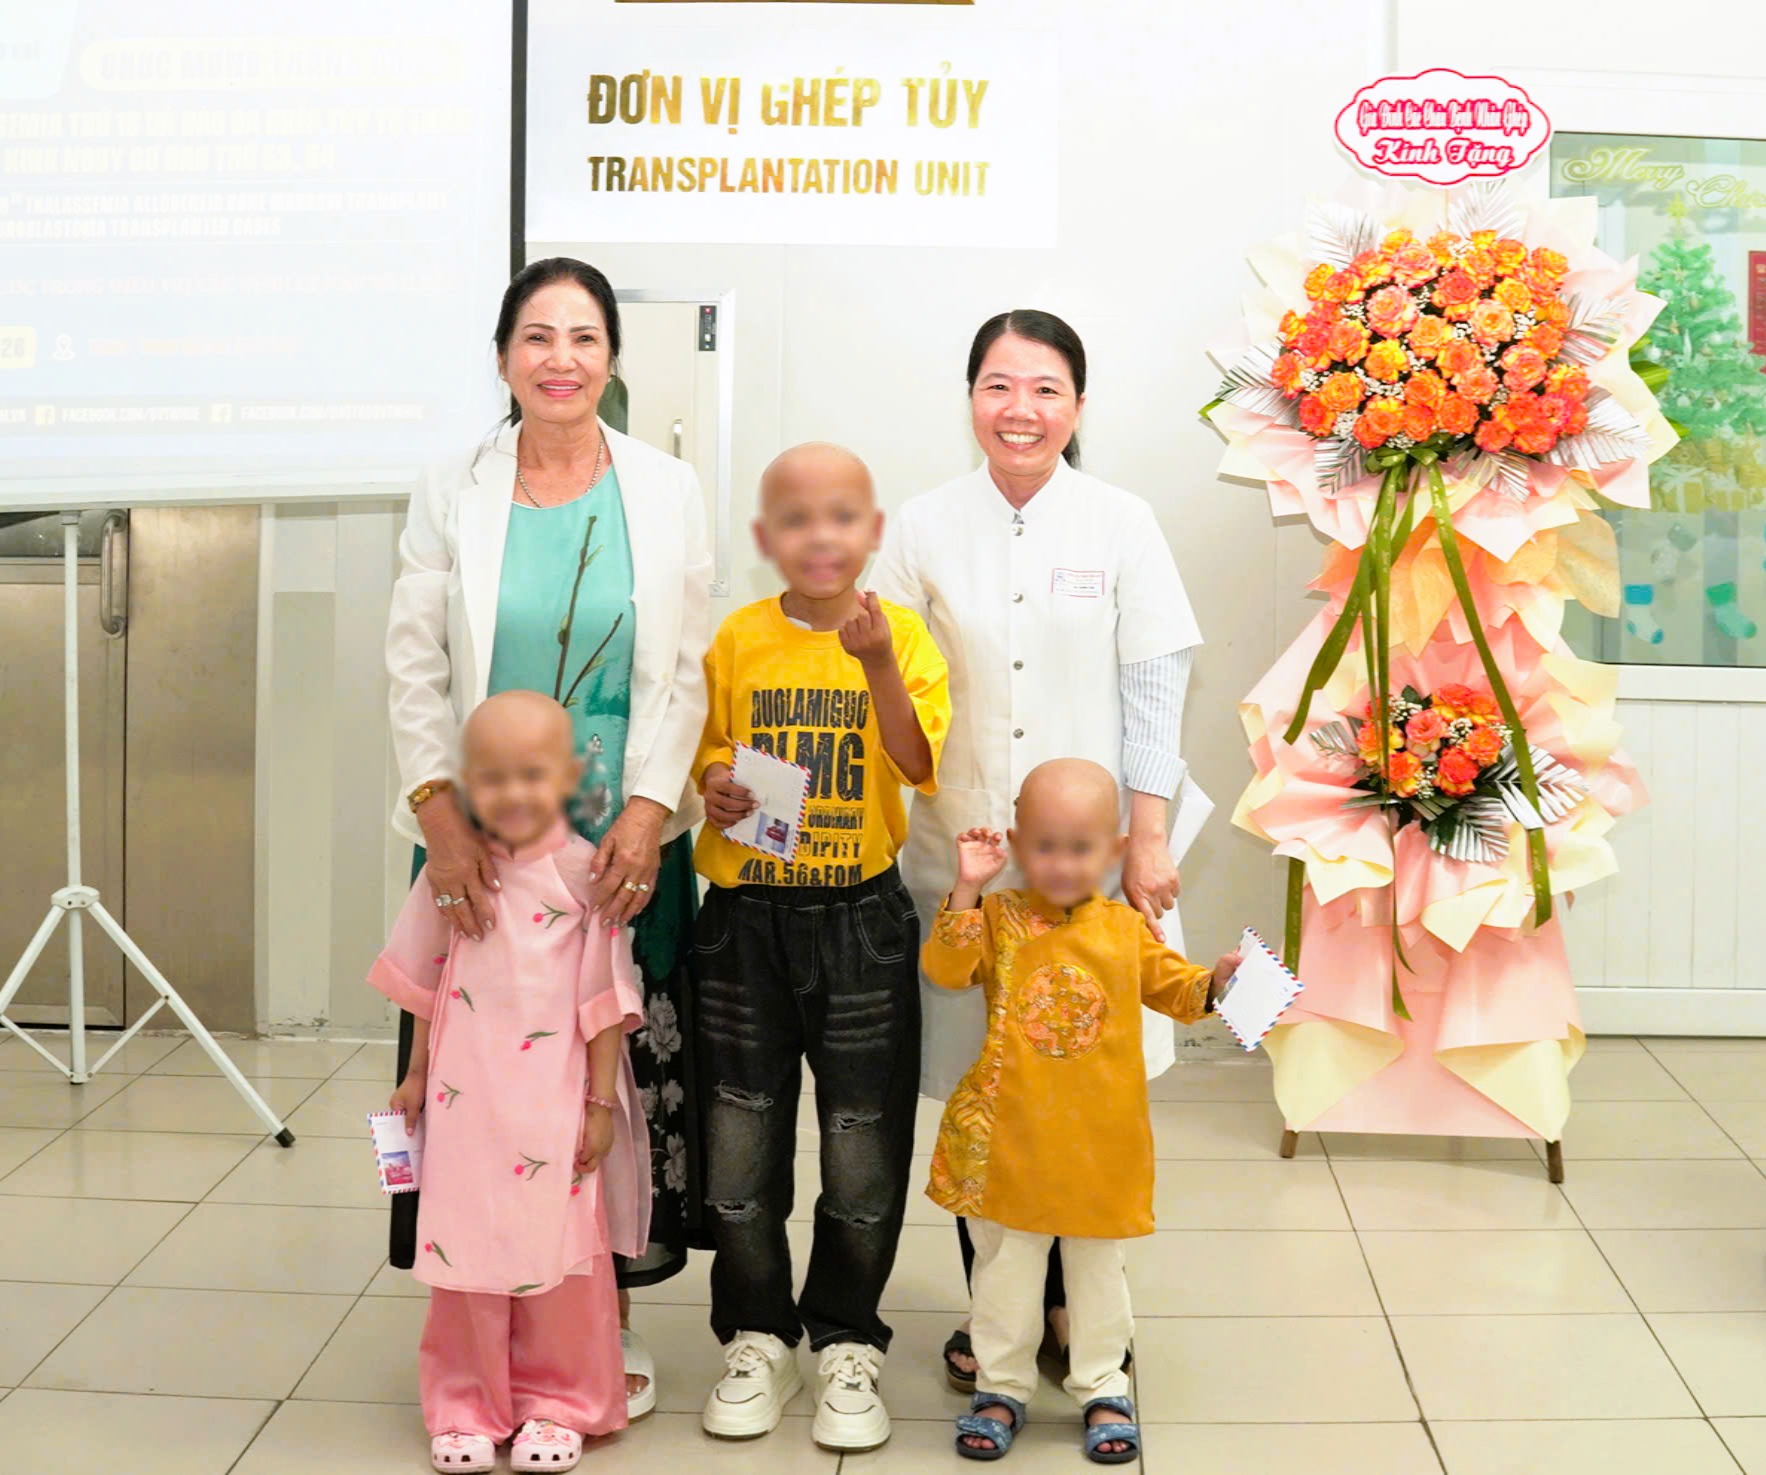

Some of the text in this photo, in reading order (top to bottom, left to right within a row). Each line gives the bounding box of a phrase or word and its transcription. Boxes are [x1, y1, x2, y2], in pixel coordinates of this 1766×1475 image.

[586, 60, 989, 135] ĐƠN VỊ GHÉP TỦY
[1372, 137, 1515, 170] Kính Tặng
[1562, 146, 1685, 191] Merry
[587, 156, 990, 197] TRANSPLANTATION UNIT
